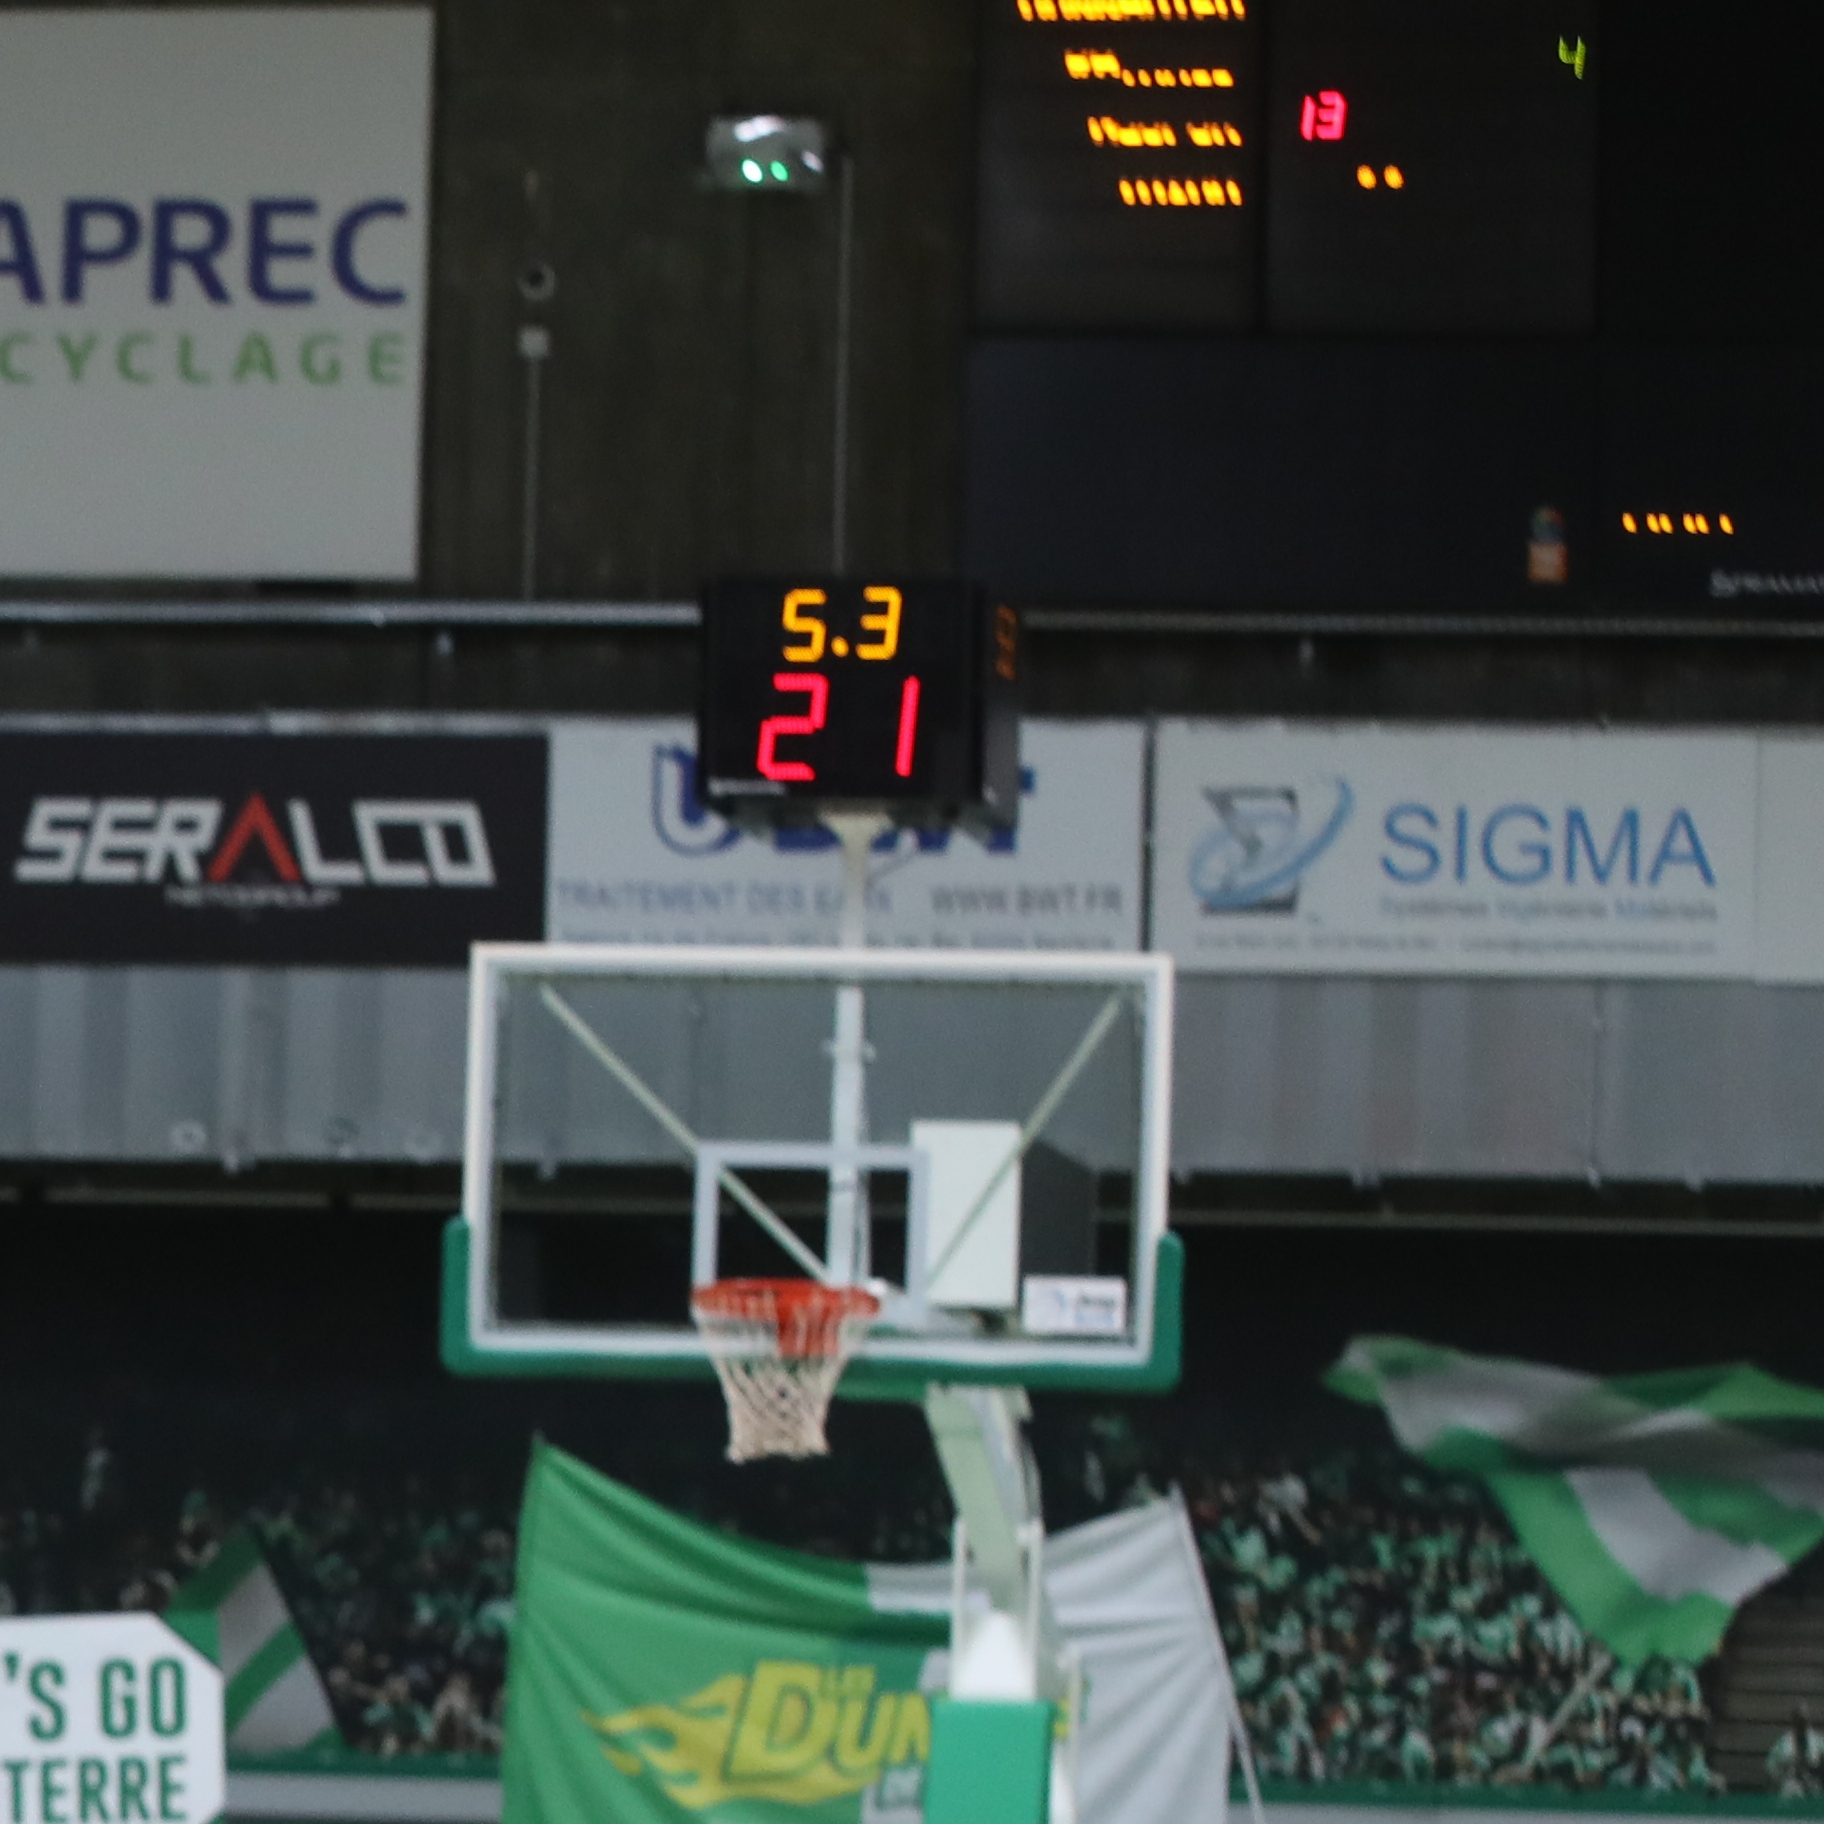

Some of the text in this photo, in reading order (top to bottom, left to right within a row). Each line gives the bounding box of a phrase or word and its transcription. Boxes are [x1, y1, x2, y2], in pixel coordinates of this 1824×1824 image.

[1301, 89, 1347, 141] 13
[782, 586, 903, 662] 5.3
[756, 672, 921, 782] 21
[14, 791, 497, 886] SERALCO
[1380, 802, 1720, 887] SIGMA
[99, 1656, 188, 1741] GO
